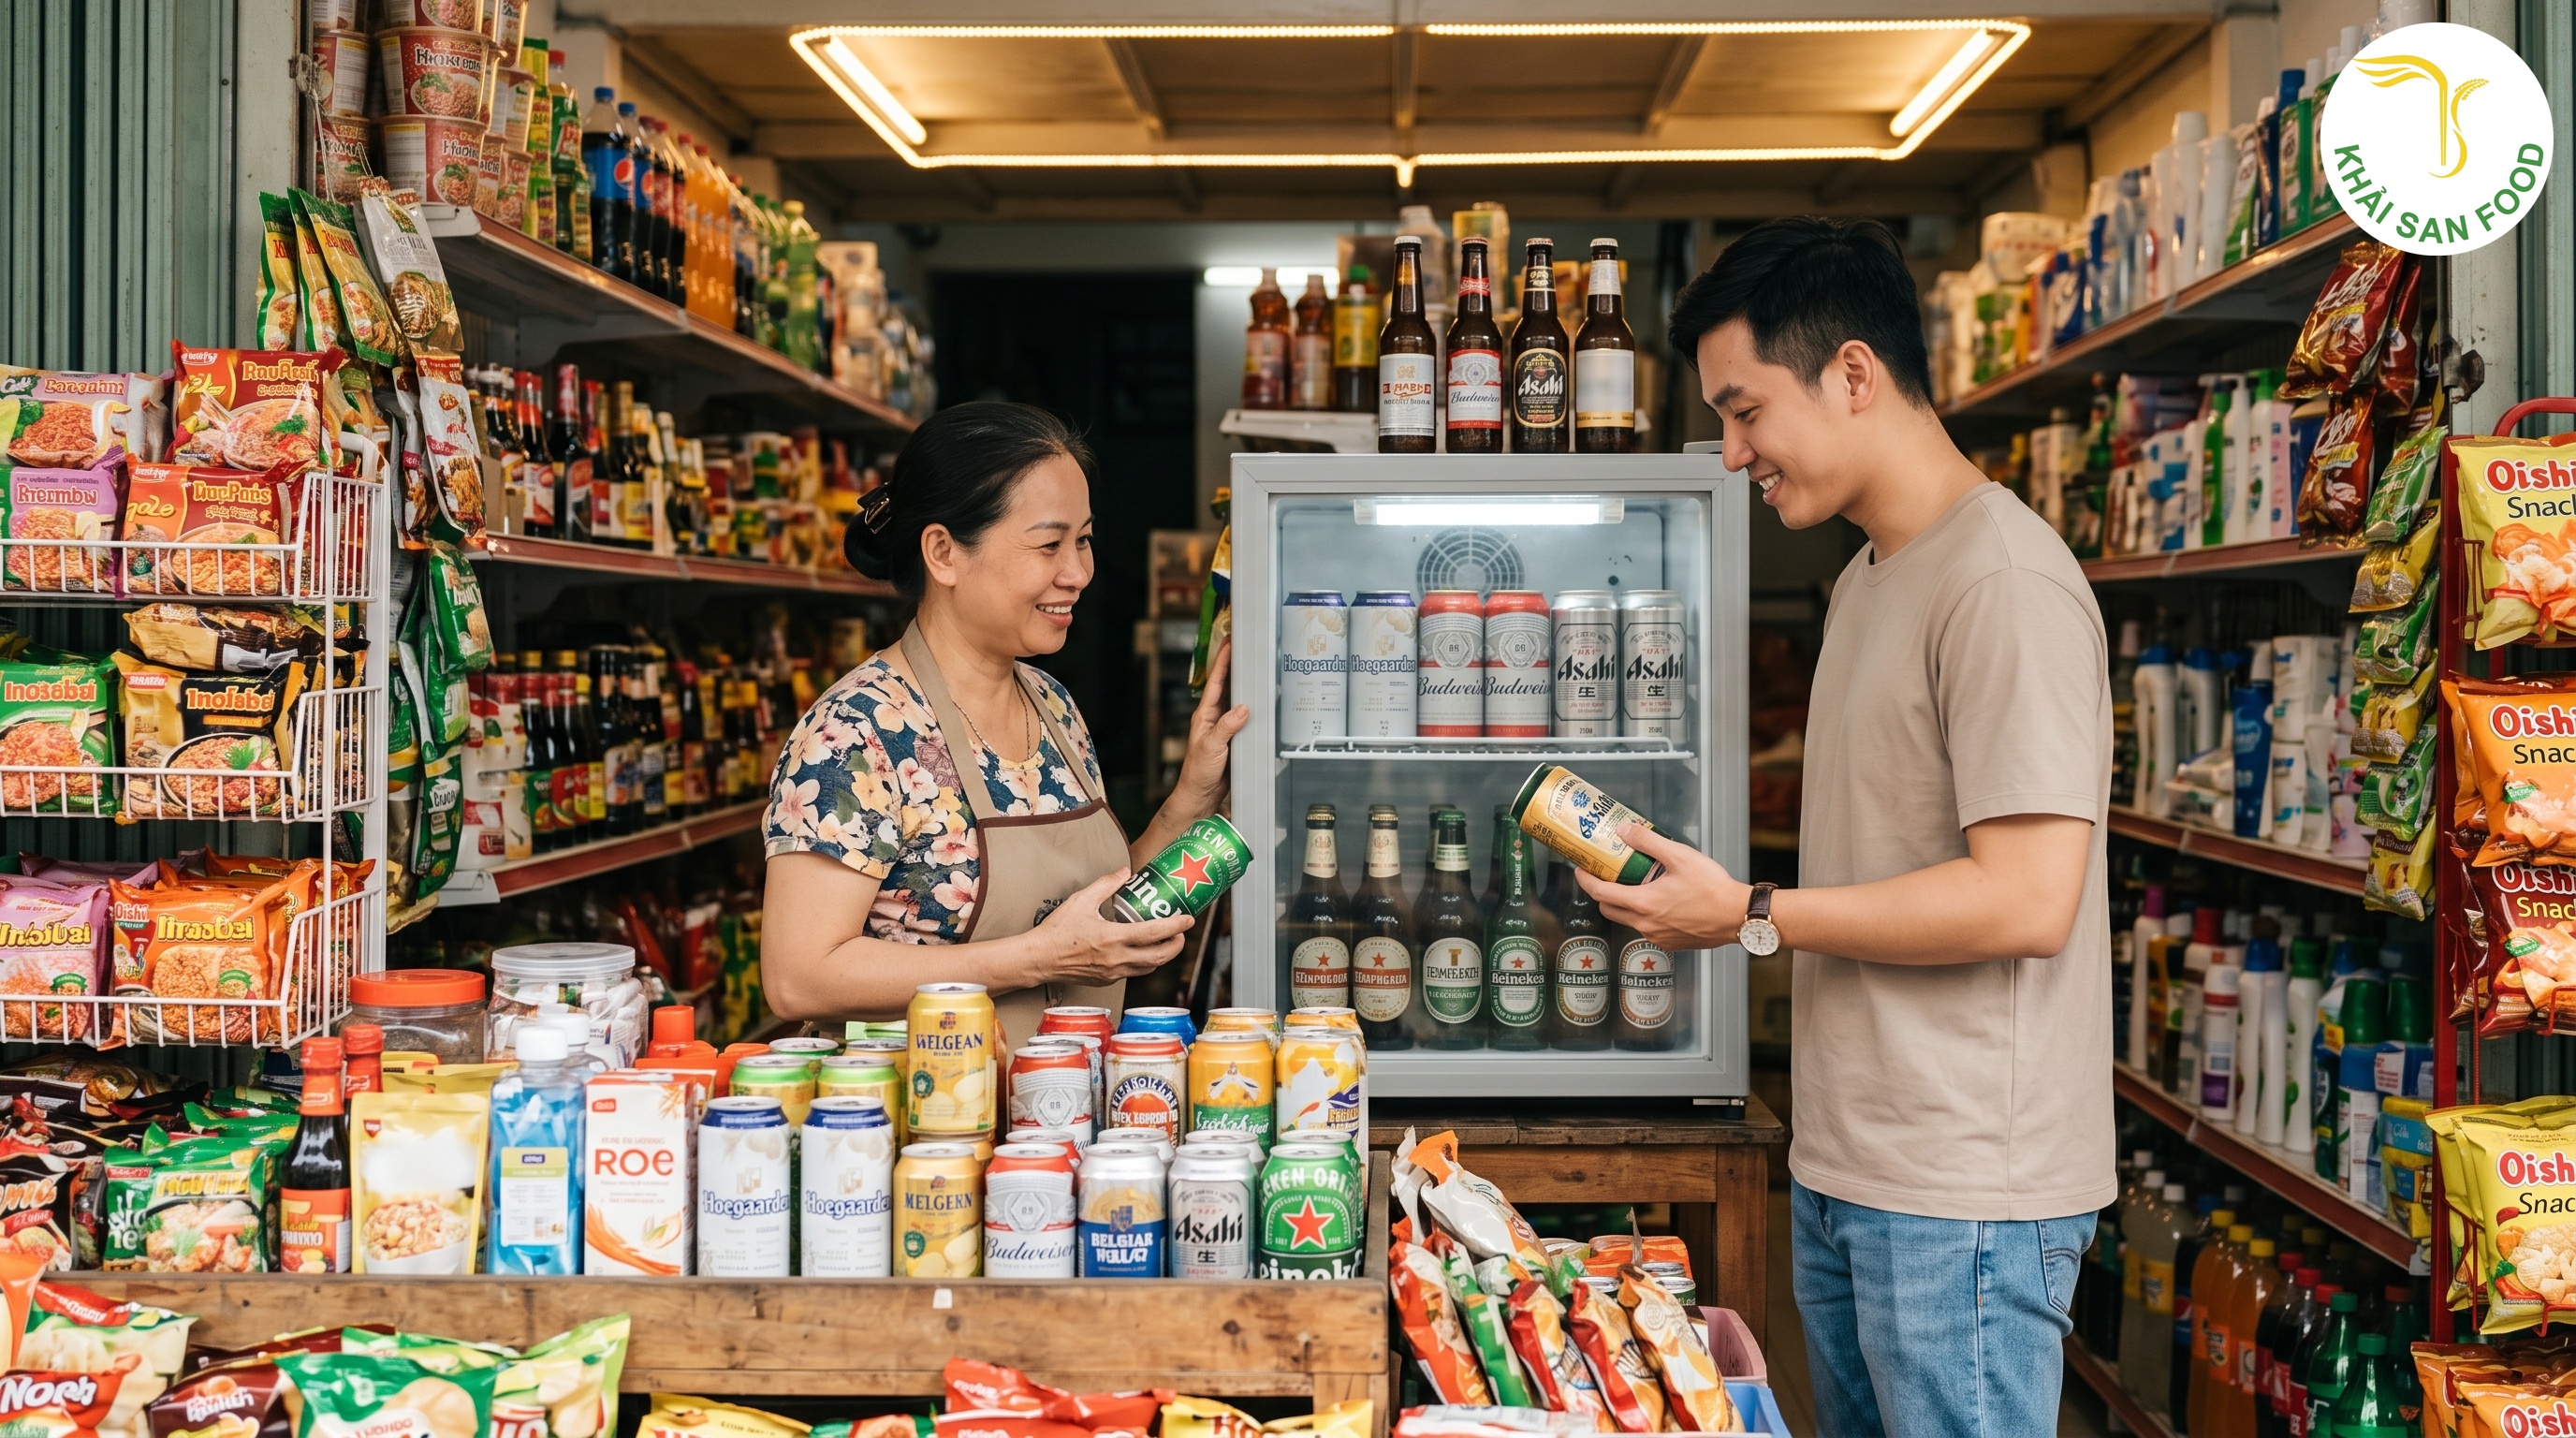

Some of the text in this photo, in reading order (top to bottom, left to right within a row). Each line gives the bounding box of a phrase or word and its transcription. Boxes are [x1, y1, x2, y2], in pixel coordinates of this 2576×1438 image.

[1557, 654, 1616, 682] Asahi
[1626, 653, 1684, 681] Asahi
[1174, 1212, 1243, 1244] Asahi
